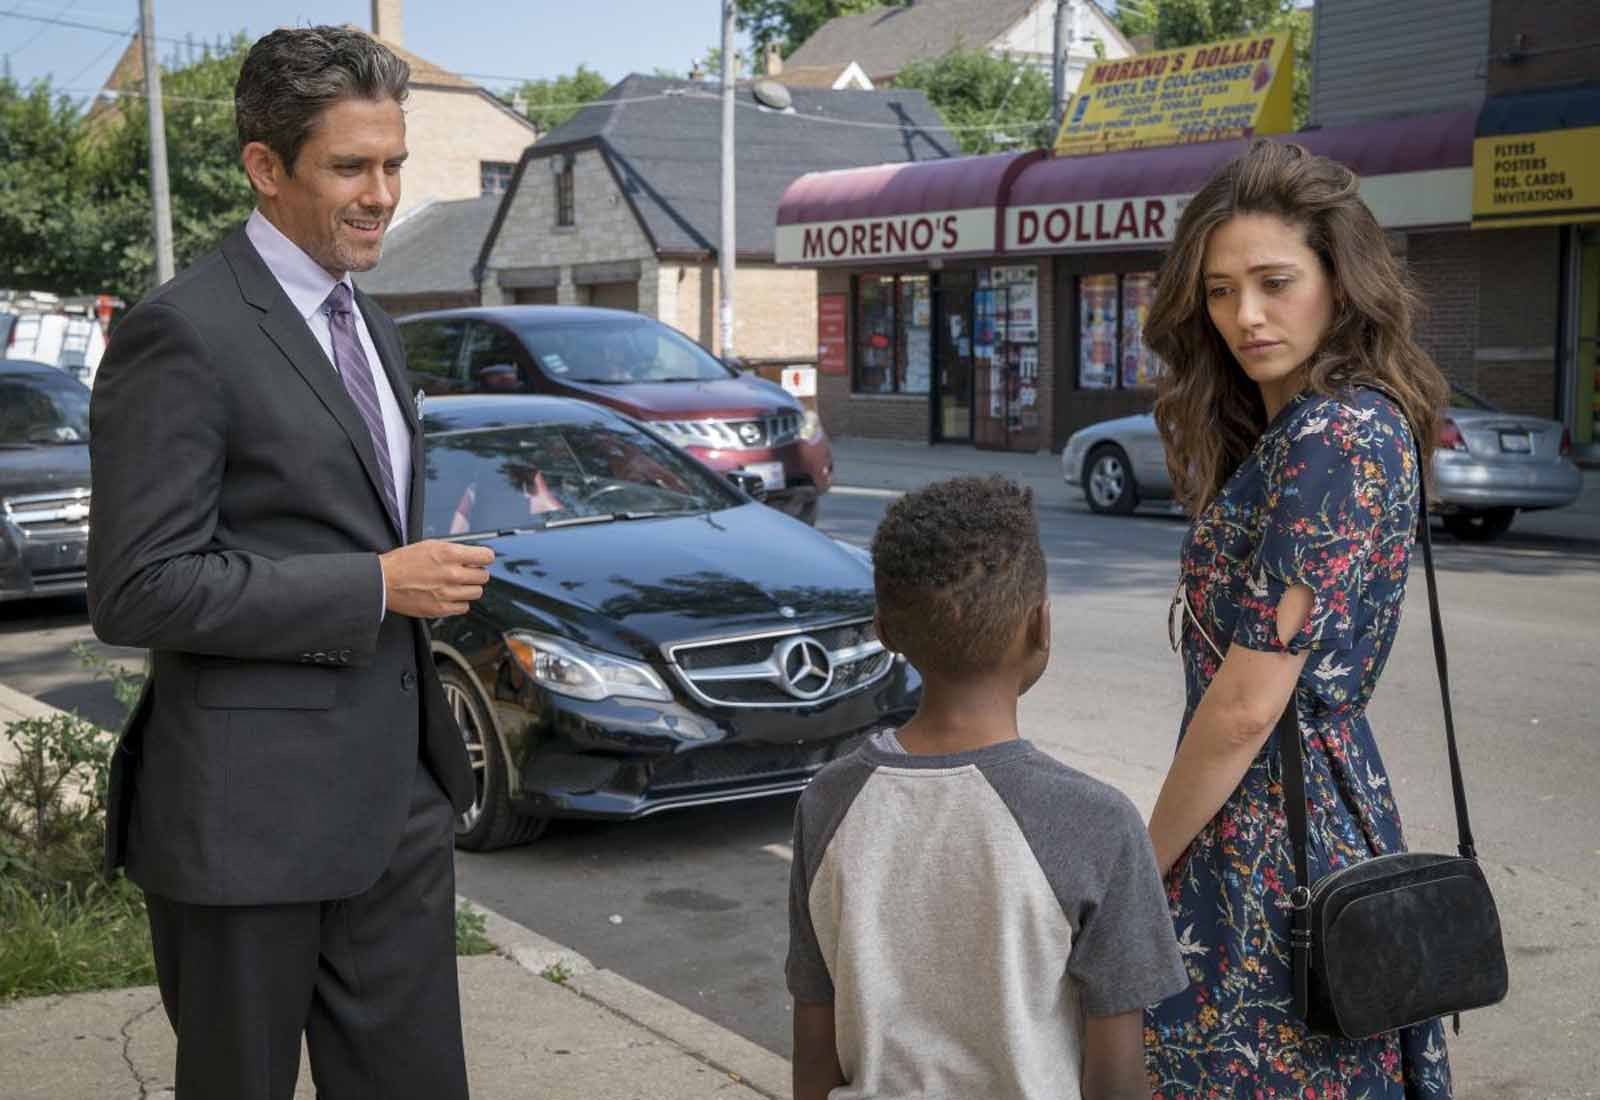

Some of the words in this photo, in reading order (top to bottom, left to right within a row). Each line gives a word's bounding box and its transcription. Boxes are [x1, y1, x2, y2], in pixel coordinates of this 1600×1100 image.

[1091, 53, 1185, 85] MORENO'S
[1192, 38, 1274, 69] DOLLAR
[1495, 158, 1546, 172] POSTERS
[803, 216, 958, 259] MORENO'S
[1018, 200, 1166, 245] DOLLAR
